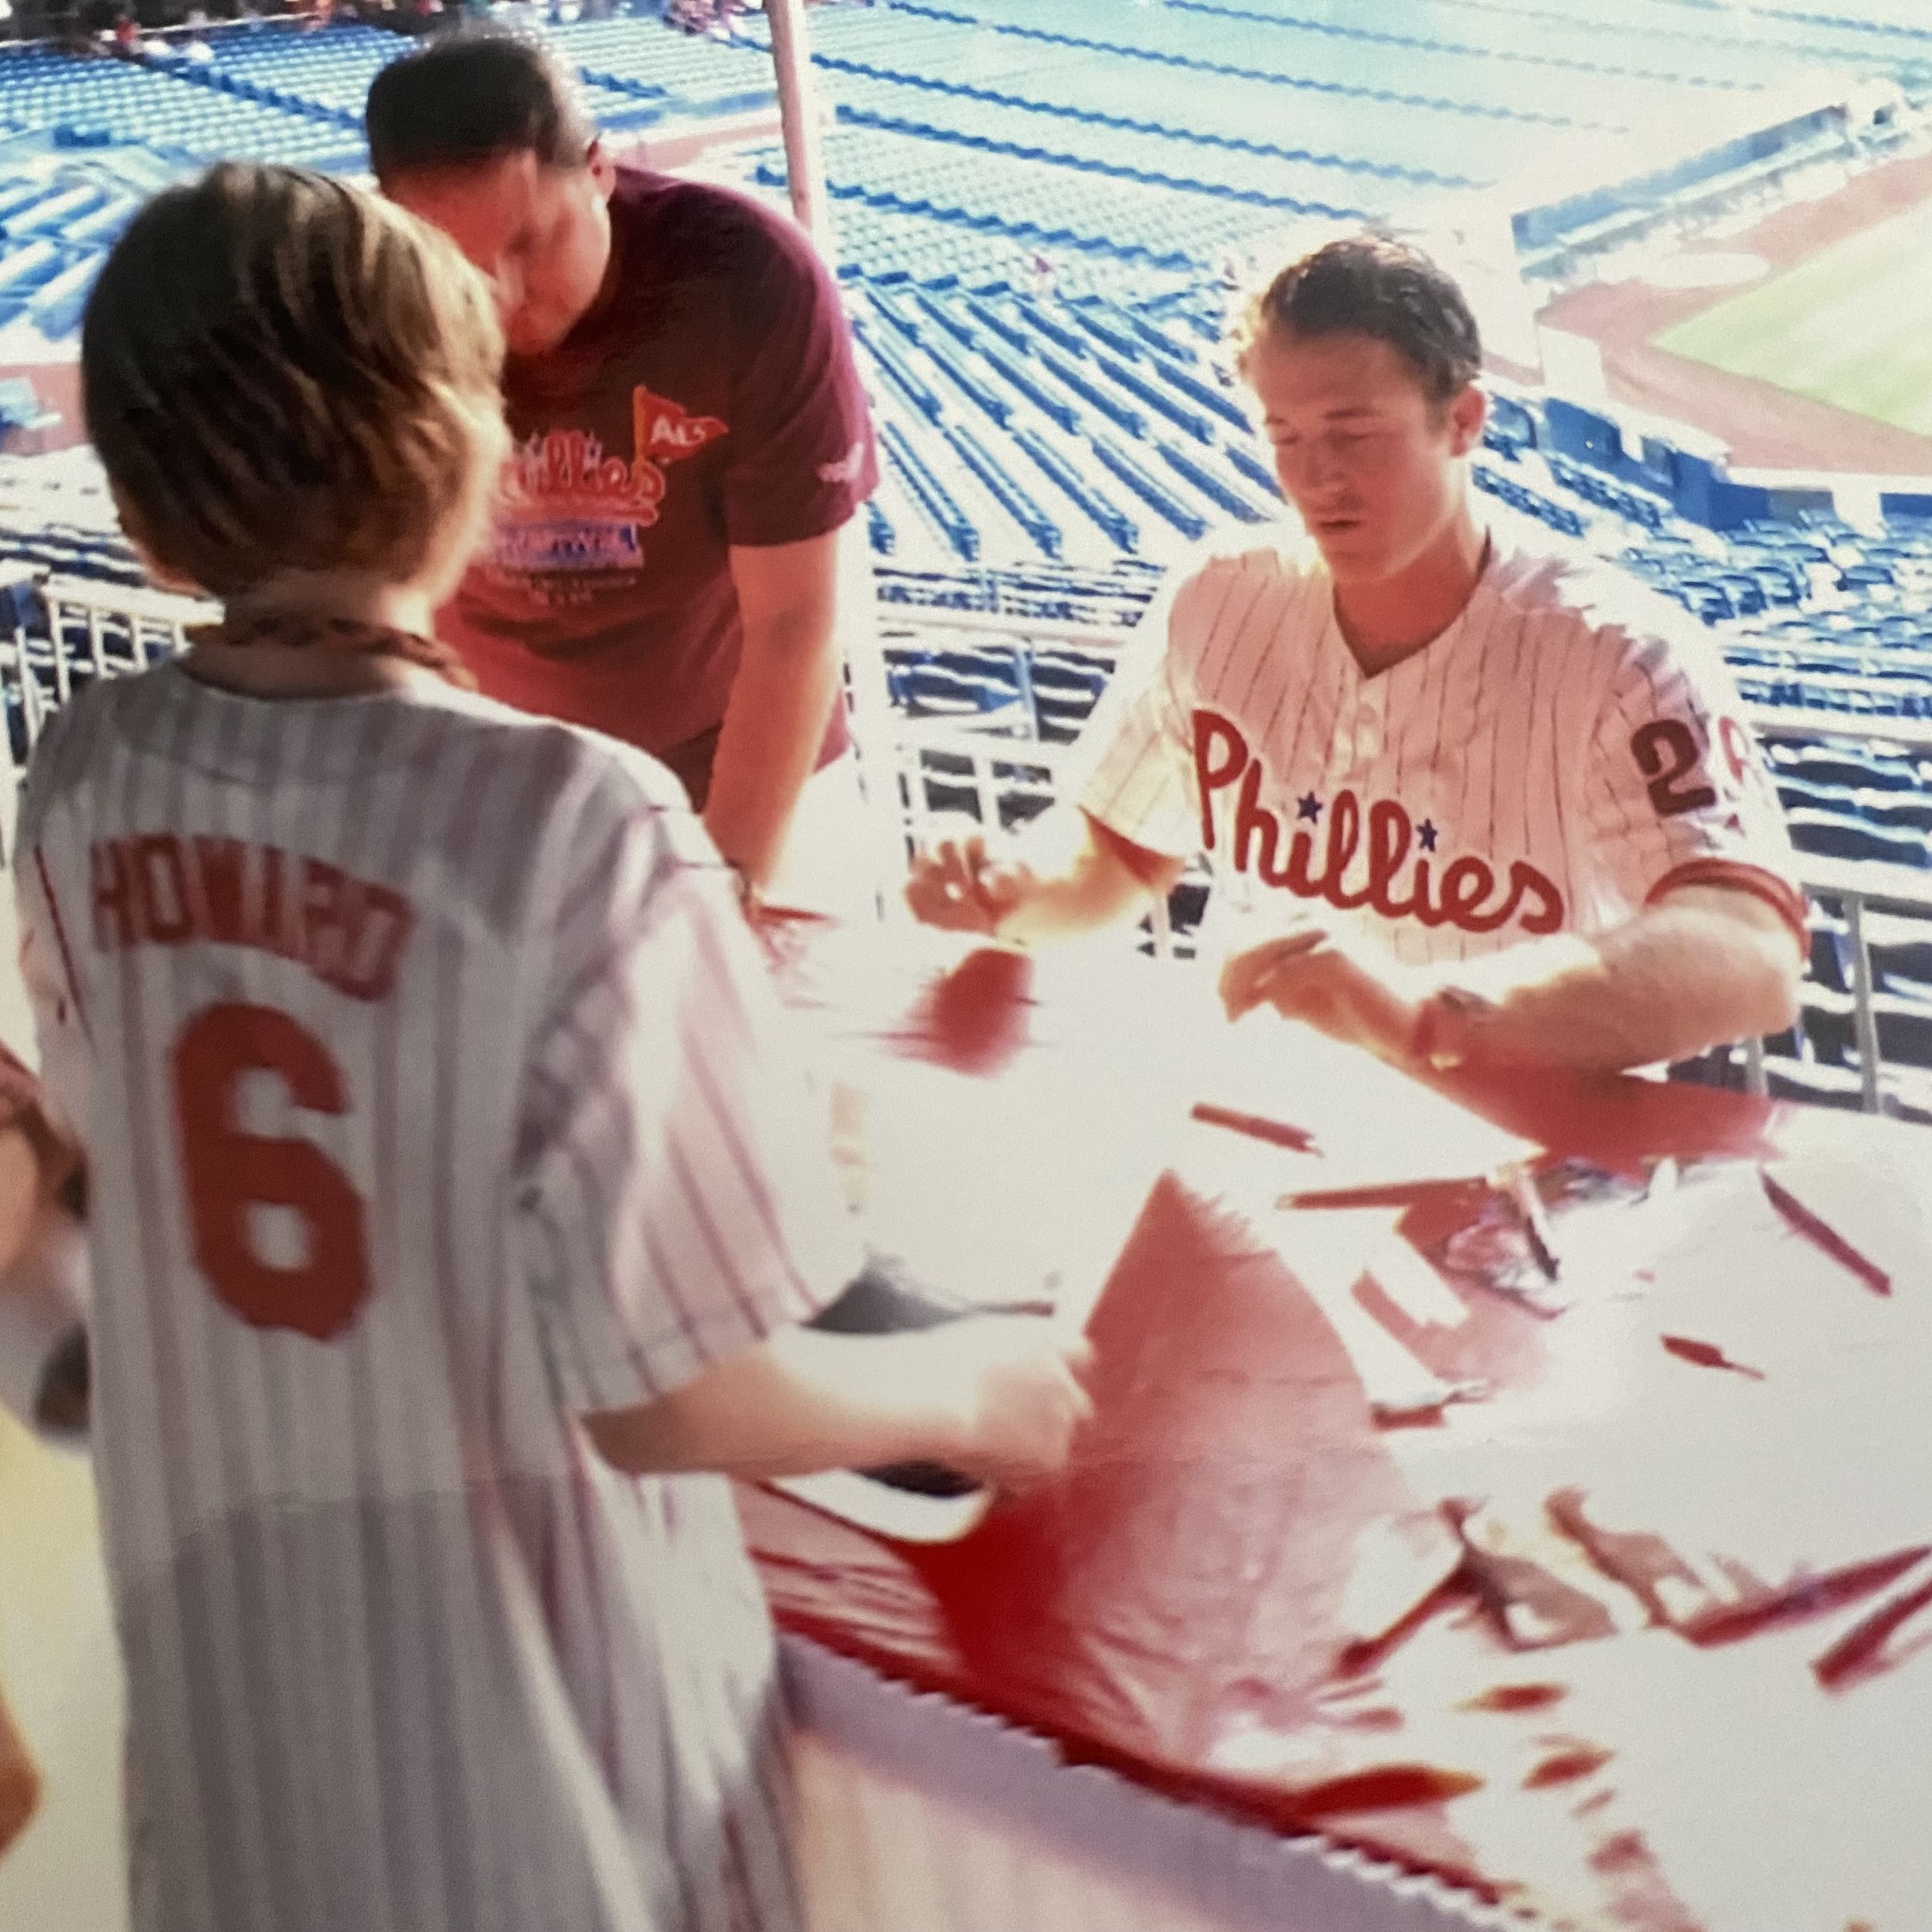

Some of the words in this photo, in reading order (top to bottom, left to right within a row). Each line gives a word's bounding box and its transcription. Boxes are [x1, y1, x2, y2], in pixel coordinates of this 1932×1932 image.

[499, 427, 665, 503] illies
[1192, 709, 1566, 935] Phillies
[170, 1000, 376, 1343] 6
